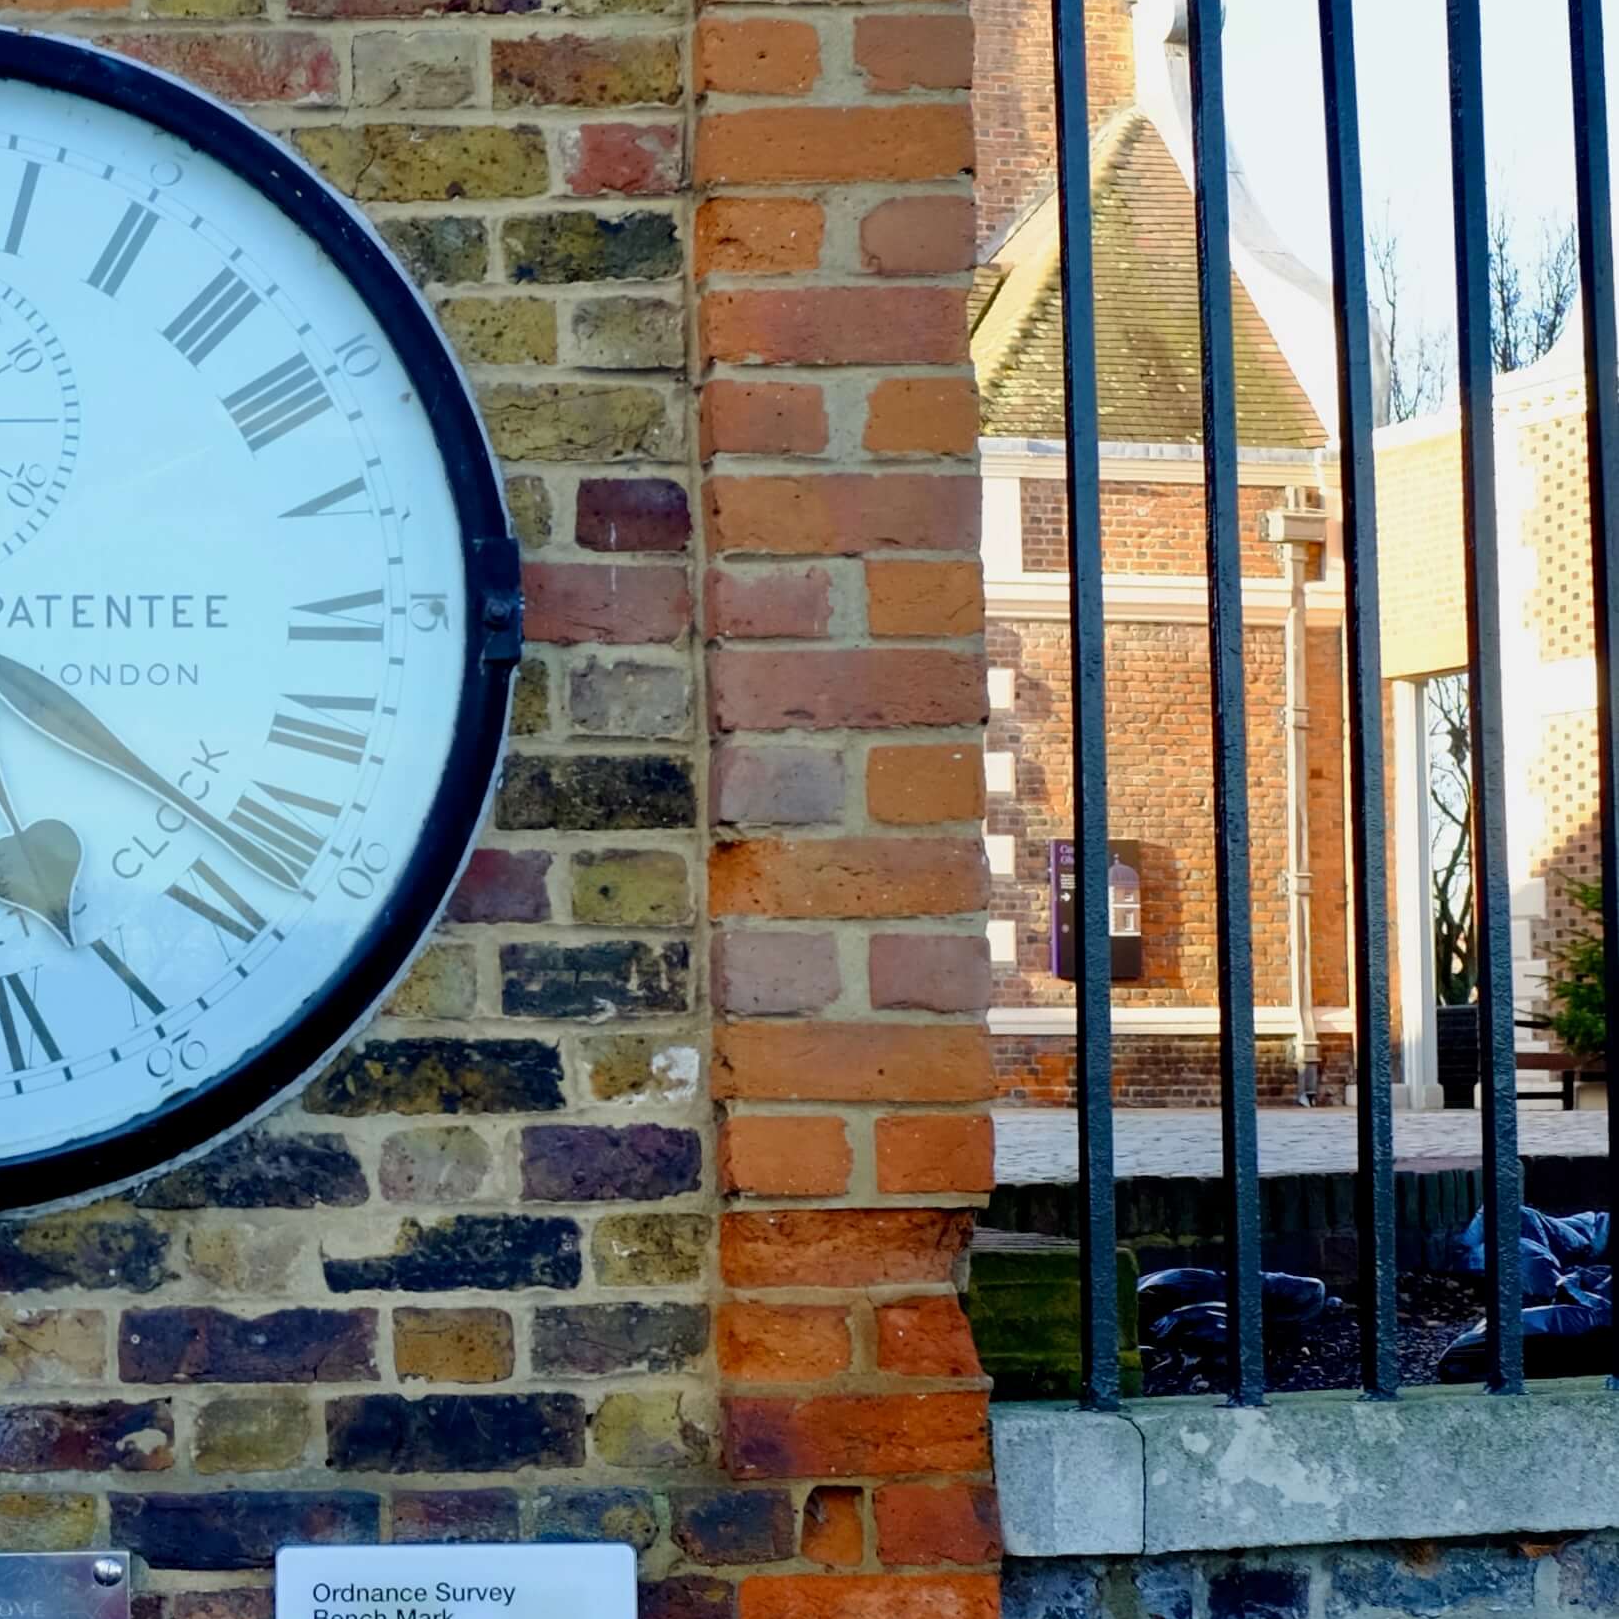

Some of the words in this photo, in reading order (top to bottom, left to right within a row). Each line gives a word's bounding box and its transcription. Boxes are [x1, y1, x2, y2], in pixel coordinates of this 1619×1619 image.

[333, 333, 381, 379] 10
[40, 663, 200, 687] ONDON
[111, 739, 230, 880] CLOCK
[312, 1582, 428, 1603] Ordnance
[435, 1582, 516, 1606] Survey
